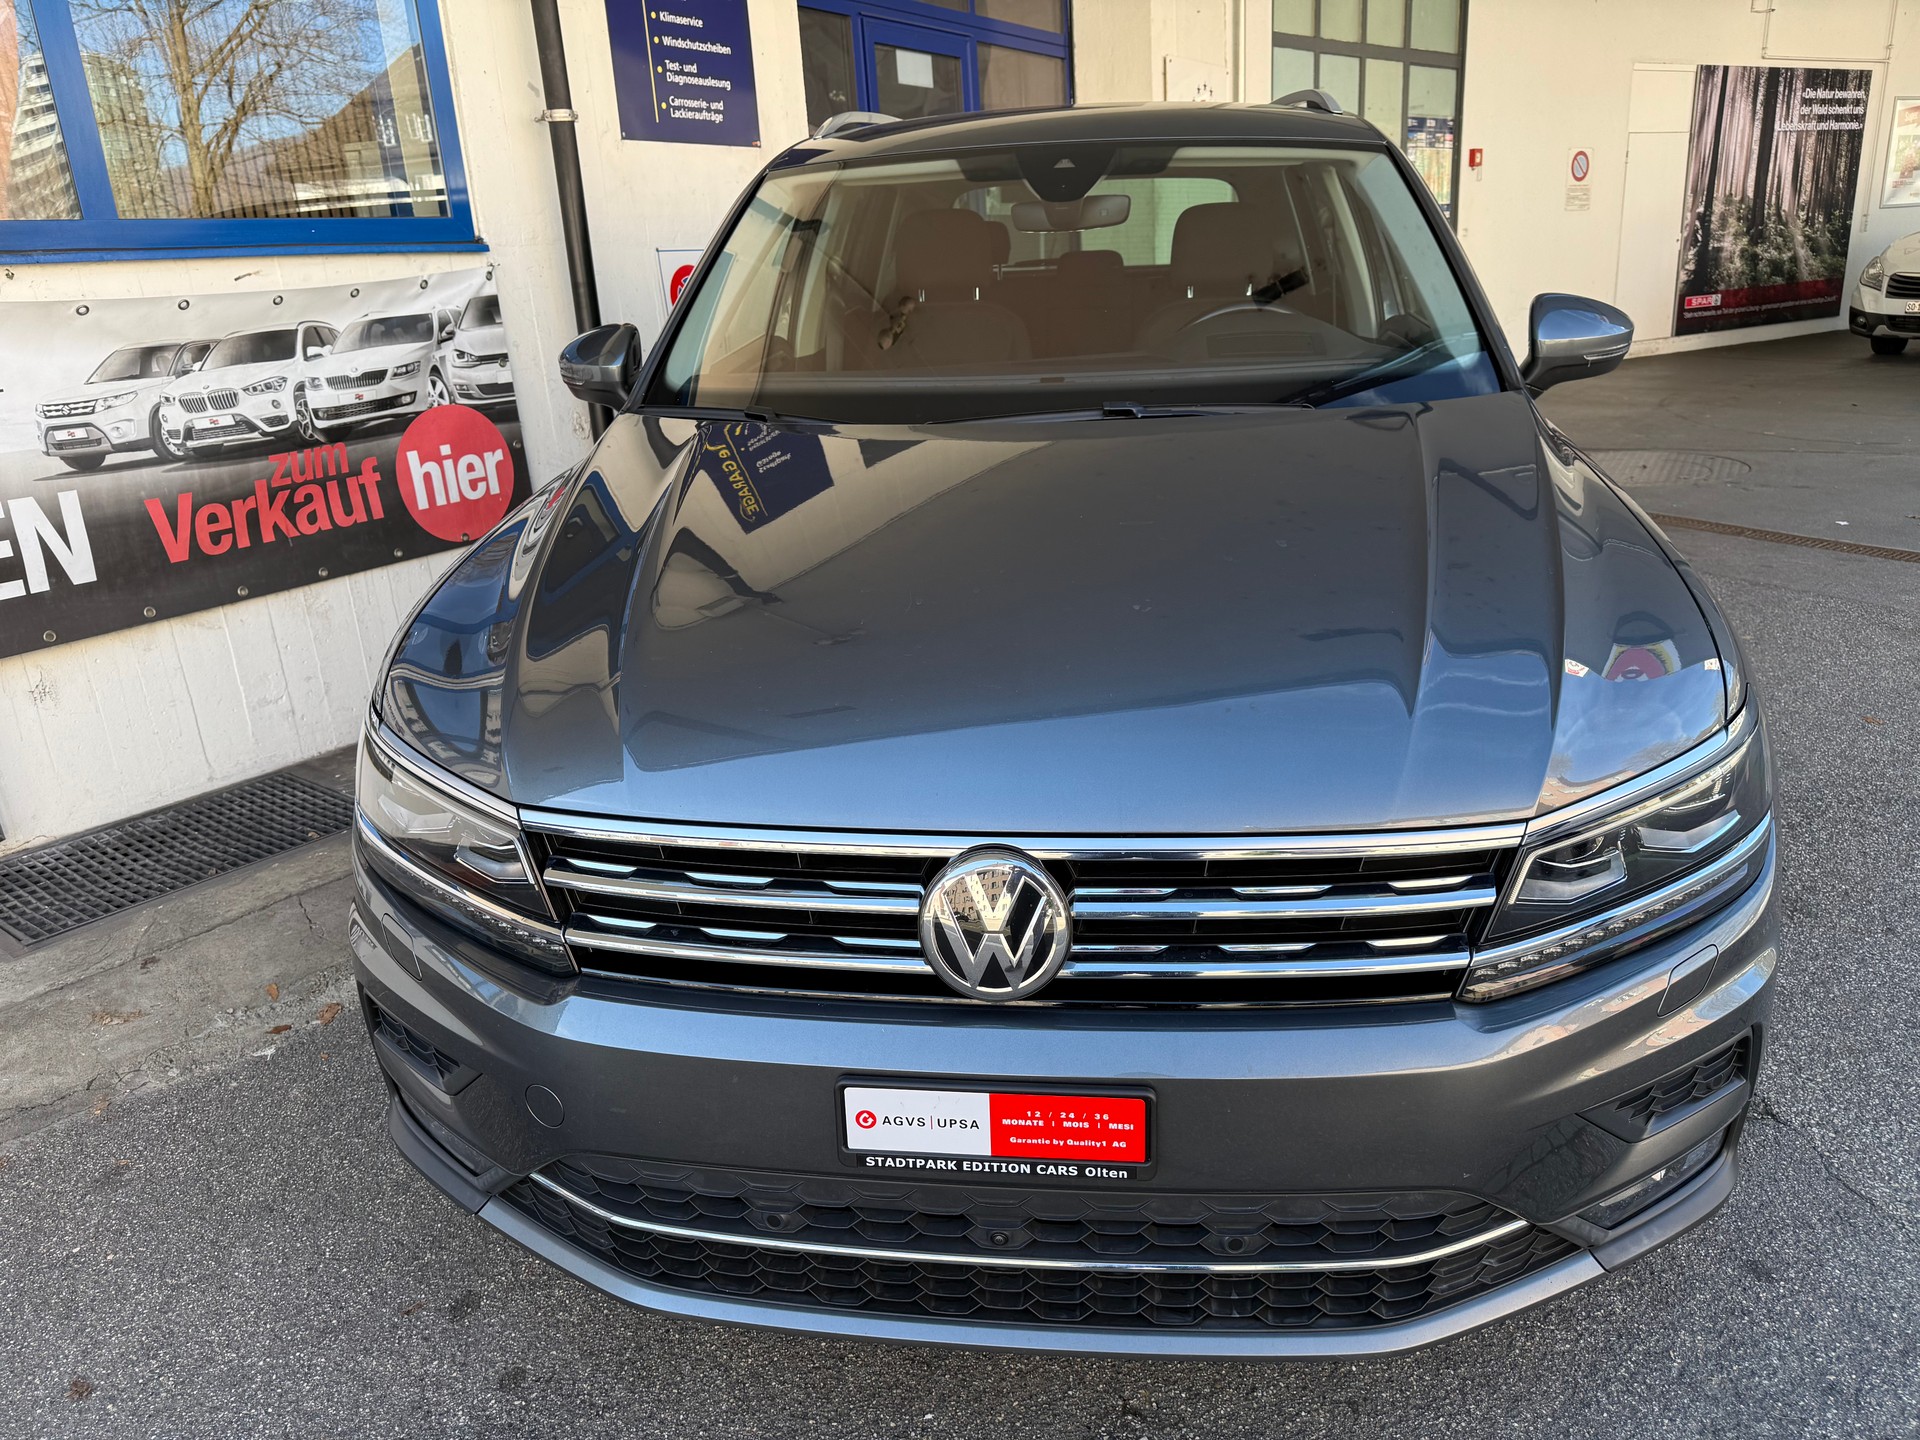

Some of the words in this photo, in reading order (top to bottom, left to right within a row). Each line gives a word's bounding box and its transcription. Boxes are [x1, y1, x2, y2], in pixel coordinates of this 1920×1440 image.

[659, 11, 703, 28] Klimaservice
[662, 35, 731, 55] Windschutzscheiben
[664, 59, 682, 72] Test-
[683, 63, 697, 73] und
[666, 72, 731, 91] Diagnoseauslesung
[1817, 88, 1834, 99] Natur
[669, 96, 709, 110] Carrosserie-
[710, 100, 724, 111] und
[1800, 104, 1811, 115] der
[1812, 104, 1828, 115] Wald
[1828, 104, 1853, 115] schenkt
[1853, 105, 1865, 115] uns
[670, 107, 724, 124] Lackieraufträge
[1817, 120, 1829, 130] und
[1691, 296, 1713, 306] SPAR
[268, 442, 350, 488] zum
[406, 445, 503, 510] hier
[144, 457, 385, 564] Verkauf
[882, 1115, 926, 1127] AGVS
[937, 1118, 980, 1130] UPSA
[1002, 1118, 1044, 1127] MONATE
[1010, 1136, 1051, 1145] Garantie
[1053, 1138, 1064, 1147] by
[1067, 1139, 1107, 1148] Quality1
[866, 1156, 957, 1170] STADTPARK
[962, 1160, 1031, 1174] EDITION
[1036, 1164, 1078, 1176] CARS
[1085, 1166, 1128, 1179] Olten
